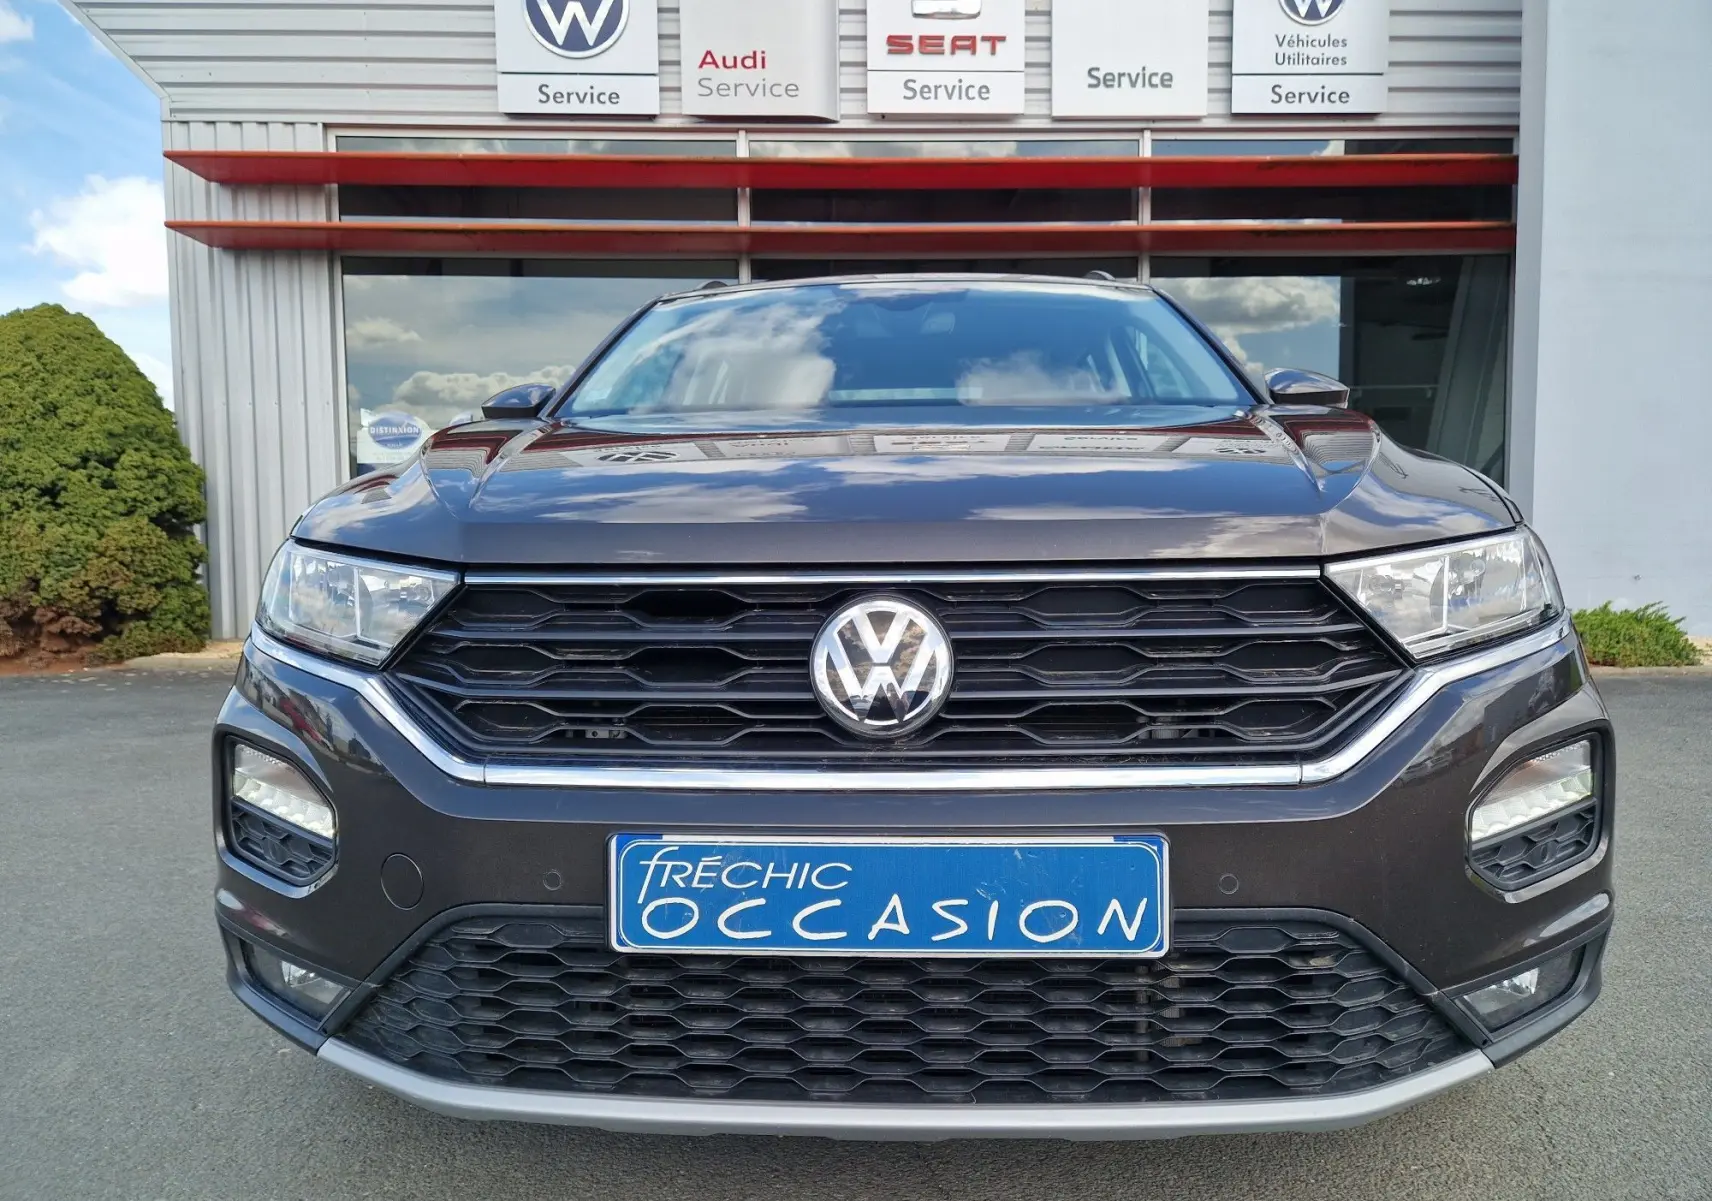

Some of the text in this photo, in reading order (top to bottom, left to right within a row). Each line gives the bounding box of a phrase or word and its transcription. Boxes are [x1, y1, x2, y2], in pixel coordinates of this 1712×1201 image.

[886, 35, 1007, 56] SEAT
[1275, 33, 1348, 48] Véhicules
[698, 50, 767, 70] Audi
[1275, 52, 1348, 66] Utilitaires
[697, 77, 800, 98] Service
[1087, 66, 1174, 89] Service
[537, 84, 620, 105] Service
[903, 79, 991, 101] Service
[1271, 84, 1350, 104] Service
[640, 893, 1148, 943] OCCASION
